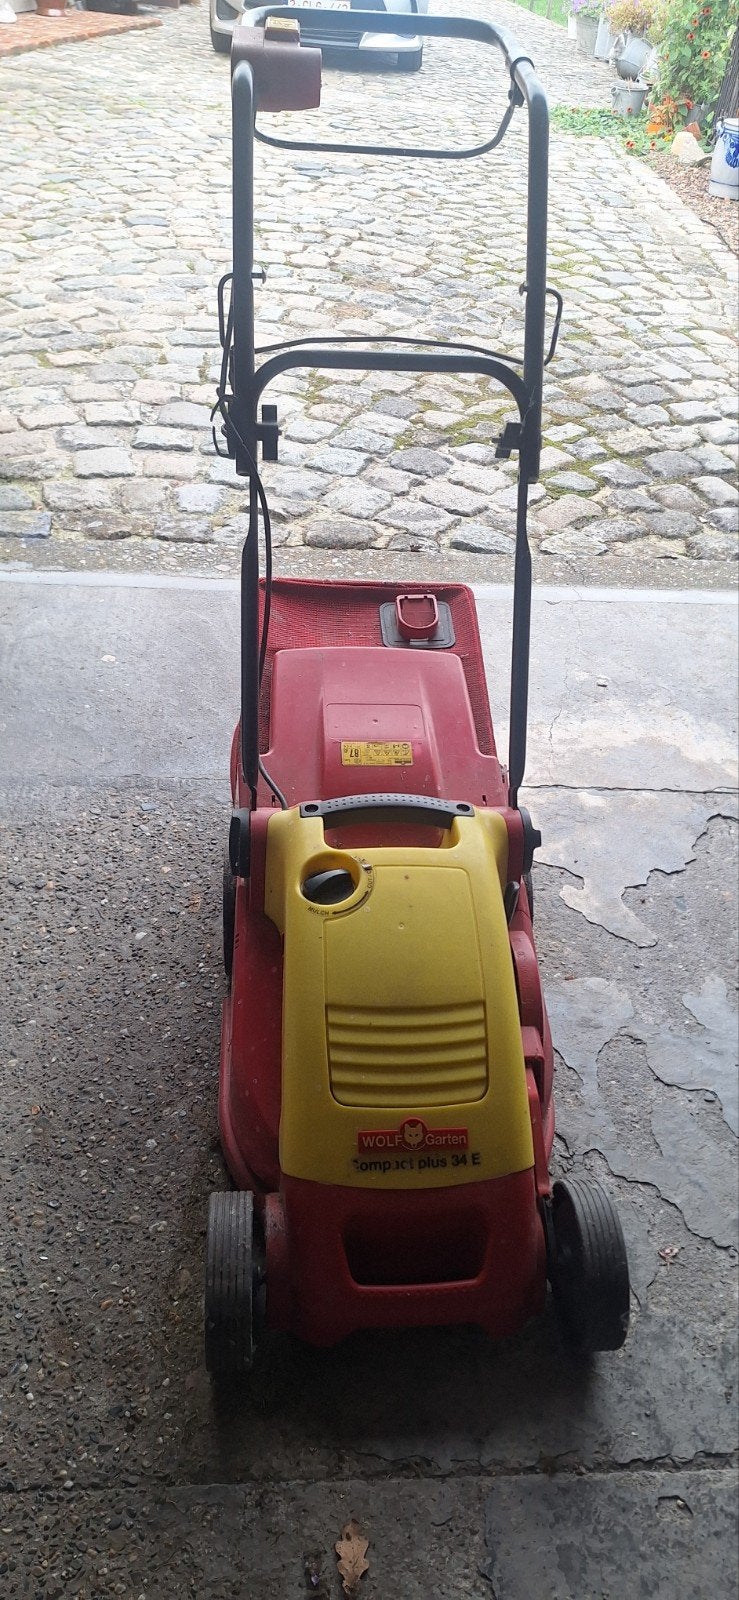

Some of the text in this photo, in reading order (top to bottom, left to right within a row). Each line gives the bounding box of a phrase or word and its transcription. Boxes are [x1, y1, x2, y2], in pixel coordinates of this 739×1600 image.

[350, 749, 359, 758] 87
[308, 905, 330, 916] MULCH
[362, 1133, 467, 1148] WOLF Garten
[419, 1156, 448, 1169] plus
[451, 1153, 468, 1167] 34
[472, 1152, 482, 1166] E
